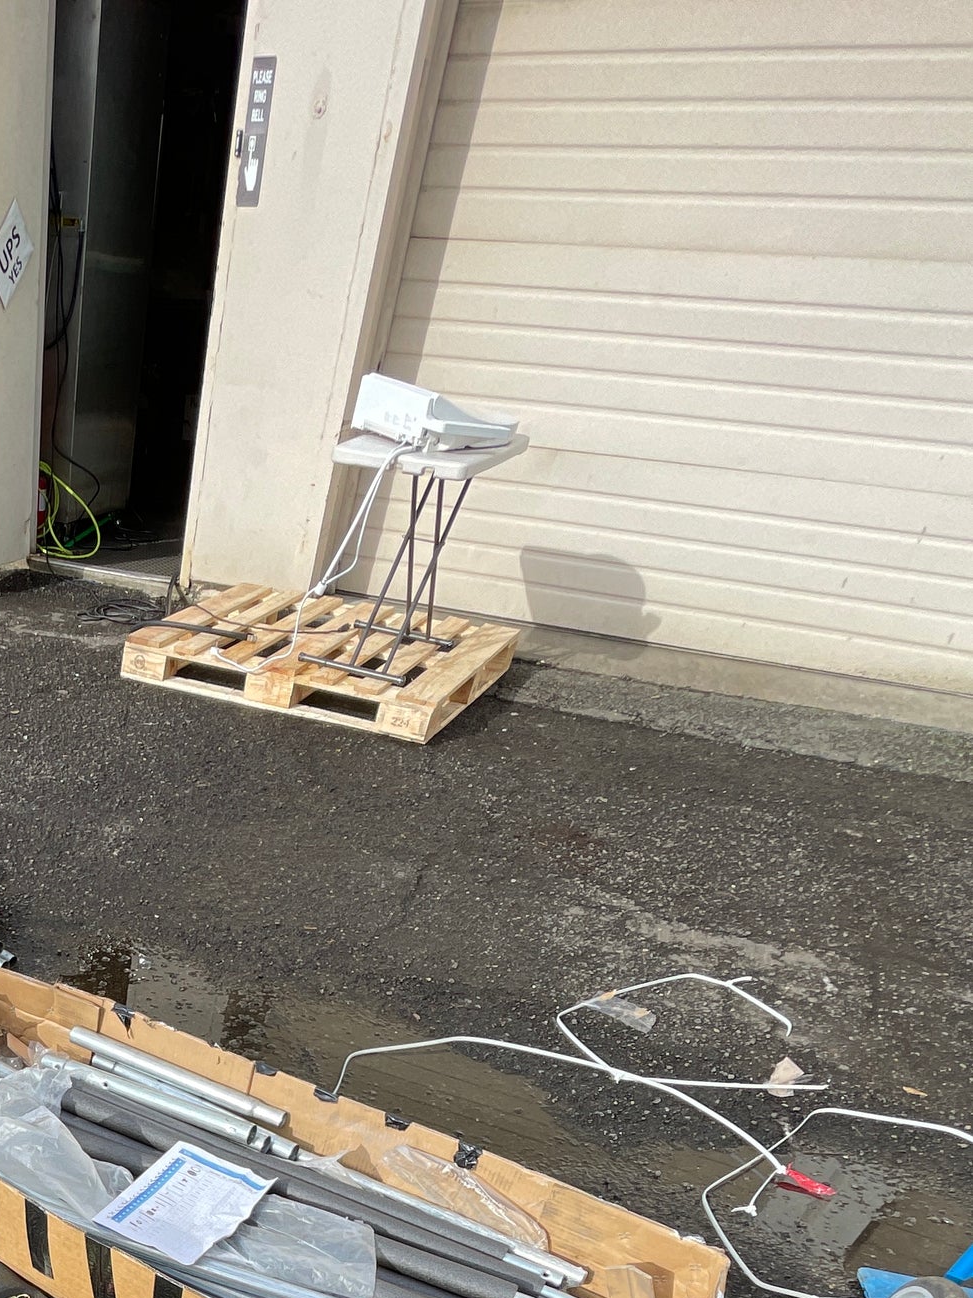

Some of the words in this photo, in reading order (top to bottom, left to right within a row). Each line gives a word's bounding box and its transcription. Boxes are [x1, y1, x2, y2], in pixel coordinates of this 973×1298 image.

[252, 70, 273, 84] PLEASE
[253, 89, 267, 103] RING
[250, 109, 264, 122] BELL
[8, 257, 23, 285] YES
